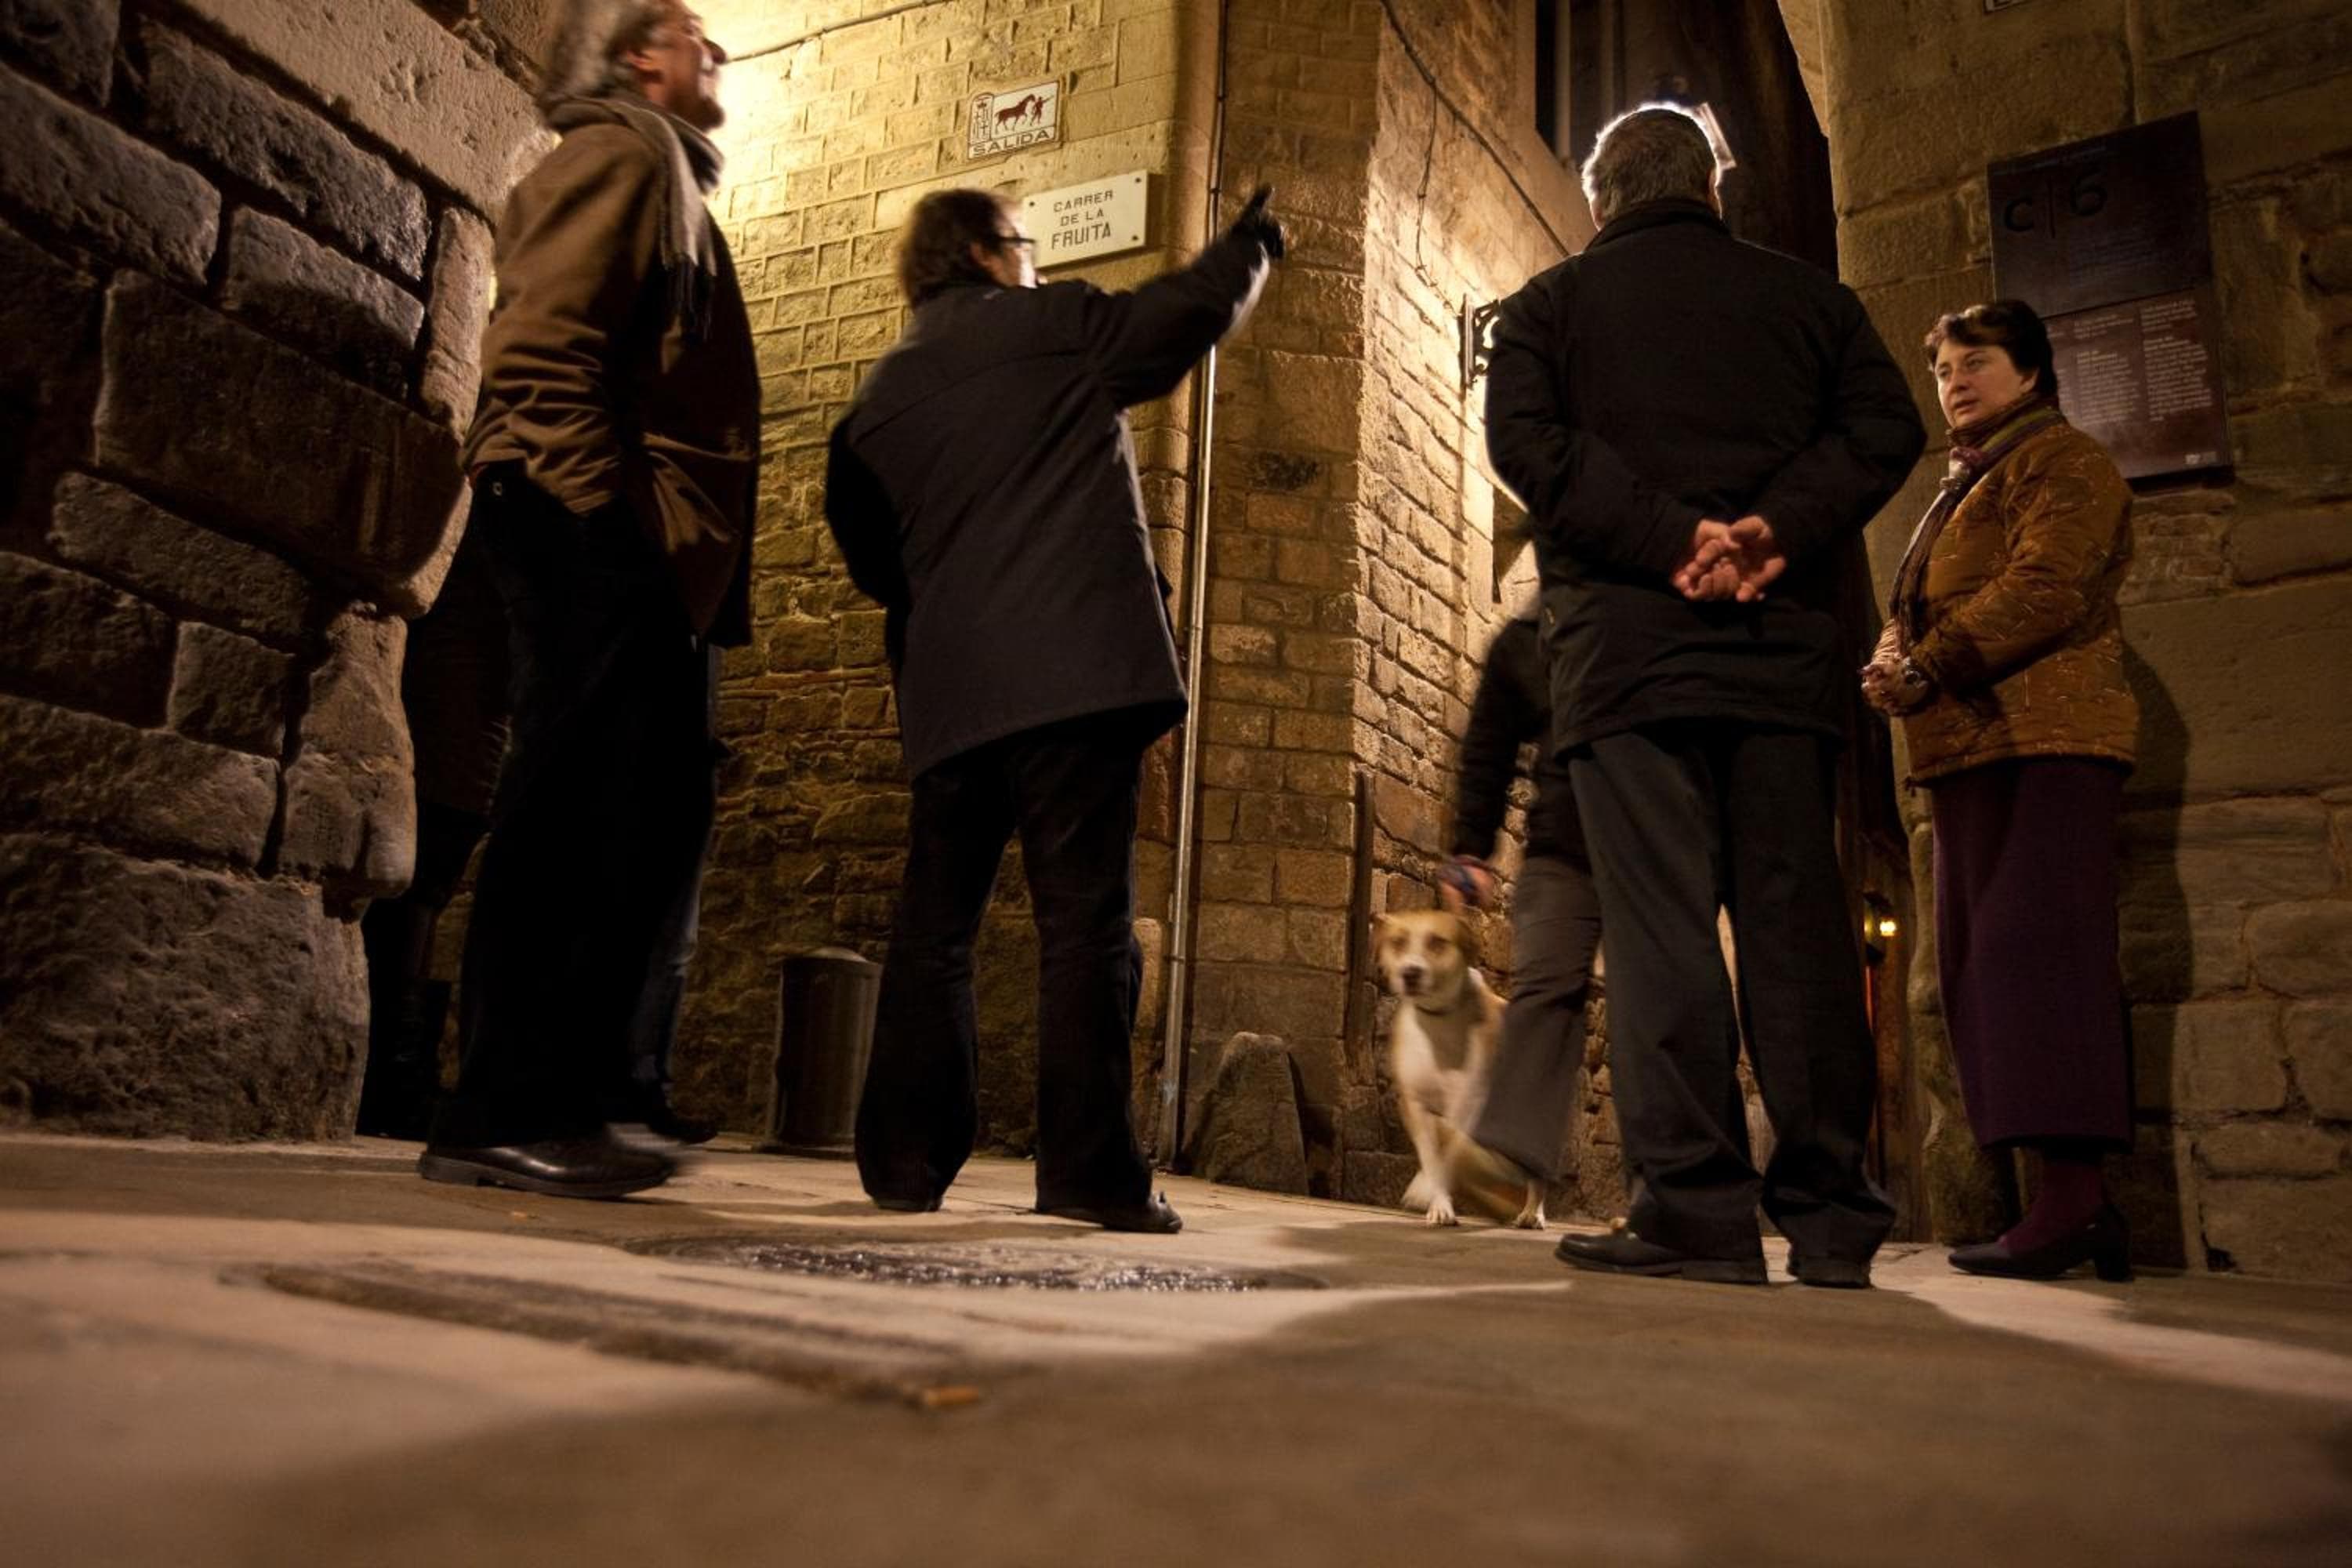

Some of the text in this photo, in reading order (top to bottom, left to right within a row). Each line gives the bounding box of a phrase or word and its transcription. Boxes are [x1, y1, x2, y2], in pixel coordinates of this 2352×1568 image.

[973, 129, 1050, 156] SALIDA
[1053, 189, 1113, 212] CARRER
[1060, 208, 1104, 226] DE LA
[1051, 220, 1111, 250] FRUITA
